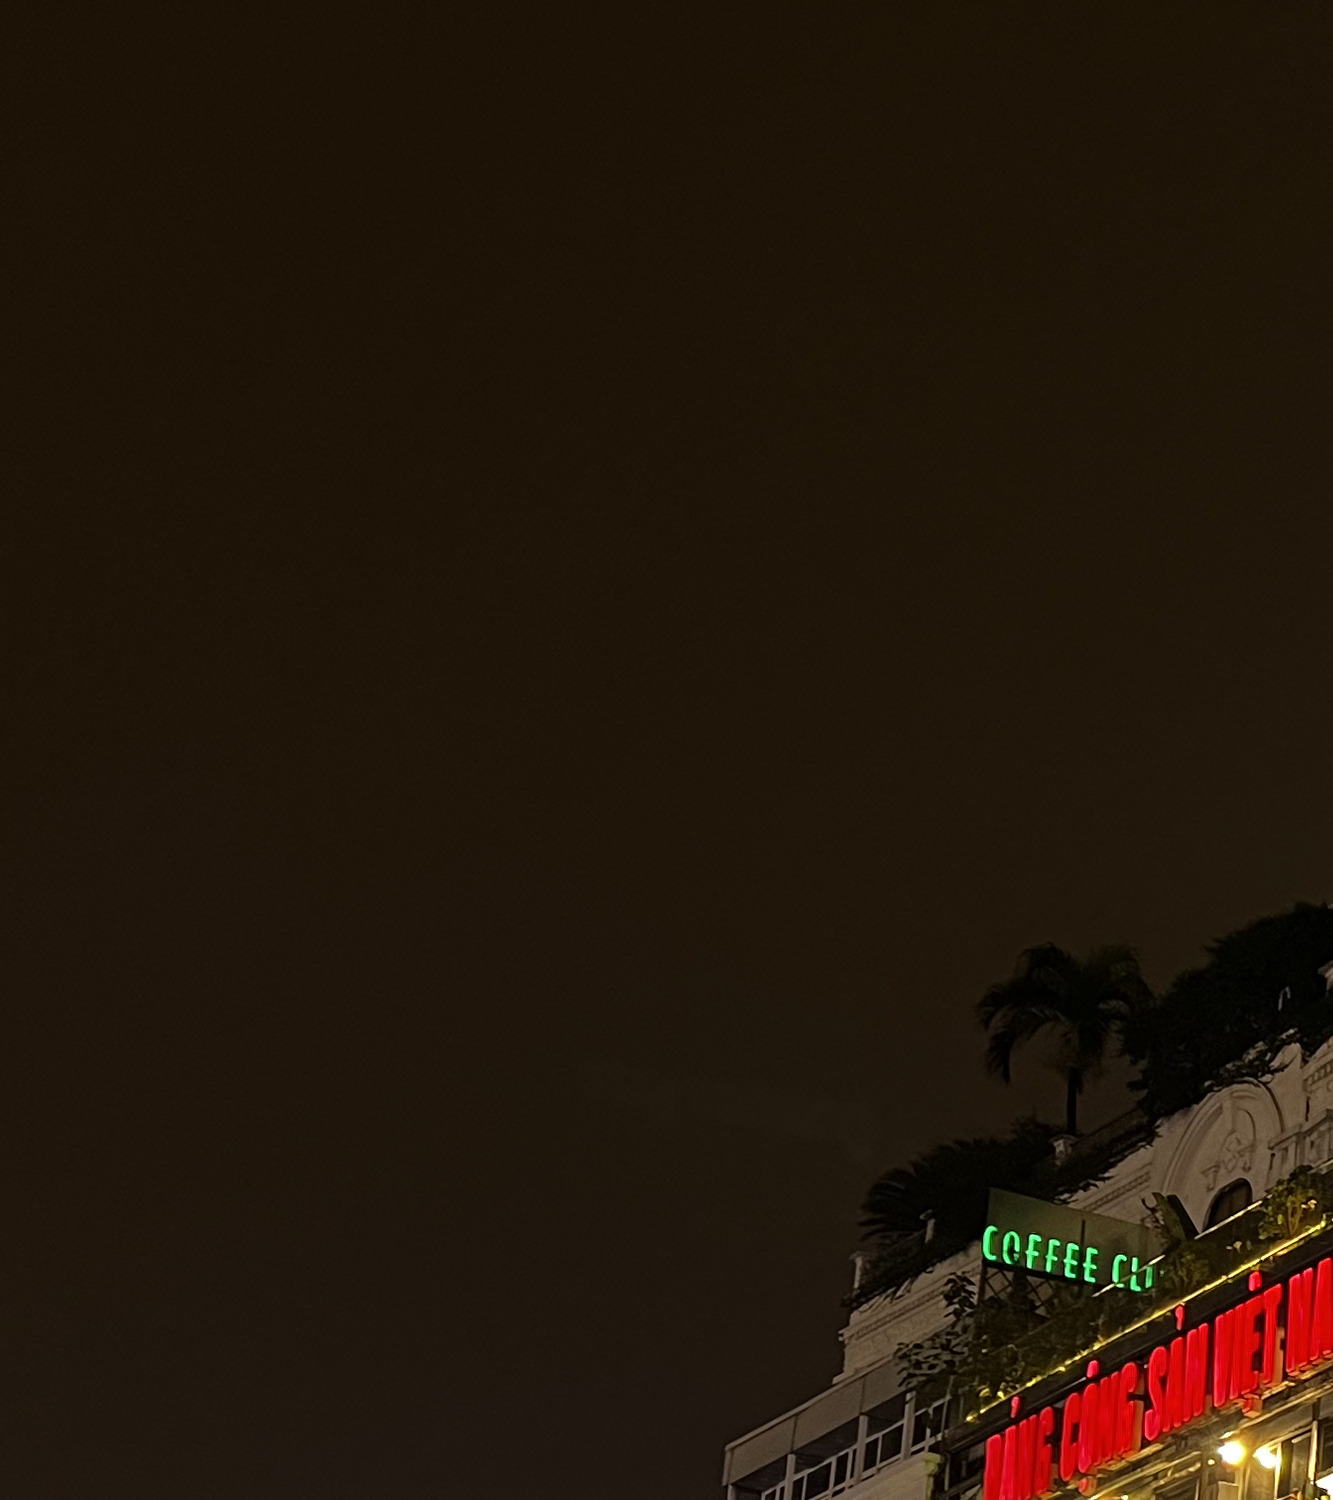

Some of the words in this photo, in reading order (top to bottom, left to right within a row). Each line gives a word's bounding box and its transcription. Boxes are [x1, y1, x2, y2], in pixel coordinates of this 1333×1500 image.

[983, 1225, 1099, 1283] COFFEE
[1145, 1305, 1209, 1440] SẢN
[1213, 1271, 1282, 1417] VIỆT
